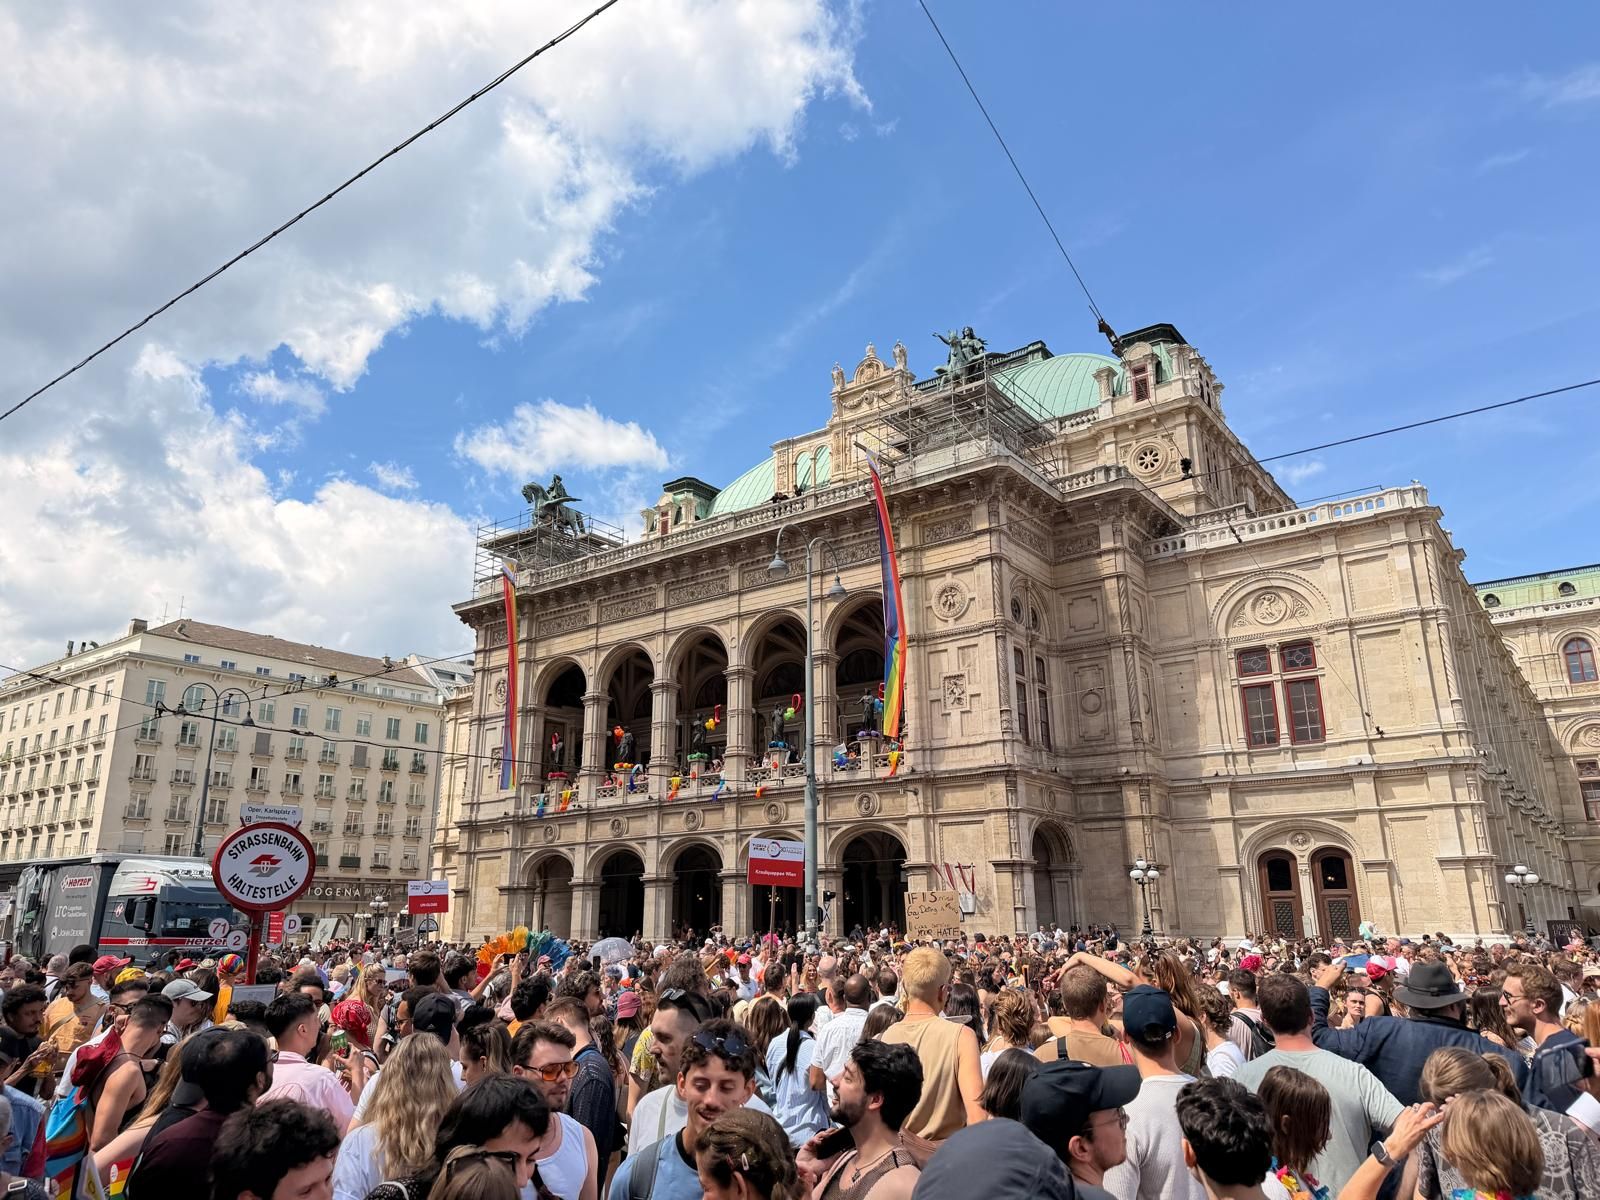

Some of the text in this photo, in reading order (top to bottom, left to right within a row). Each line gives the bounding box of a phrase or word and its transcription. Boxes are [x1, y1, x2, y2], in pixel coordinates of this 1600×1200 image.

[228, 833, 305, 862] STRASSENBAHN
[227, 873, 298, 899] HALTESTELLE
[307, 887, 392, 897] IOGENA PLAZA
[54, 905, 68, 918] LTC
[212, 922, 227, 934] 71
[288, 920, 297, 929] D
[936, 927, 960, 937] HATE
[185, 937, 228, 946] Herzer
[232, 935, 241, 946] 2
